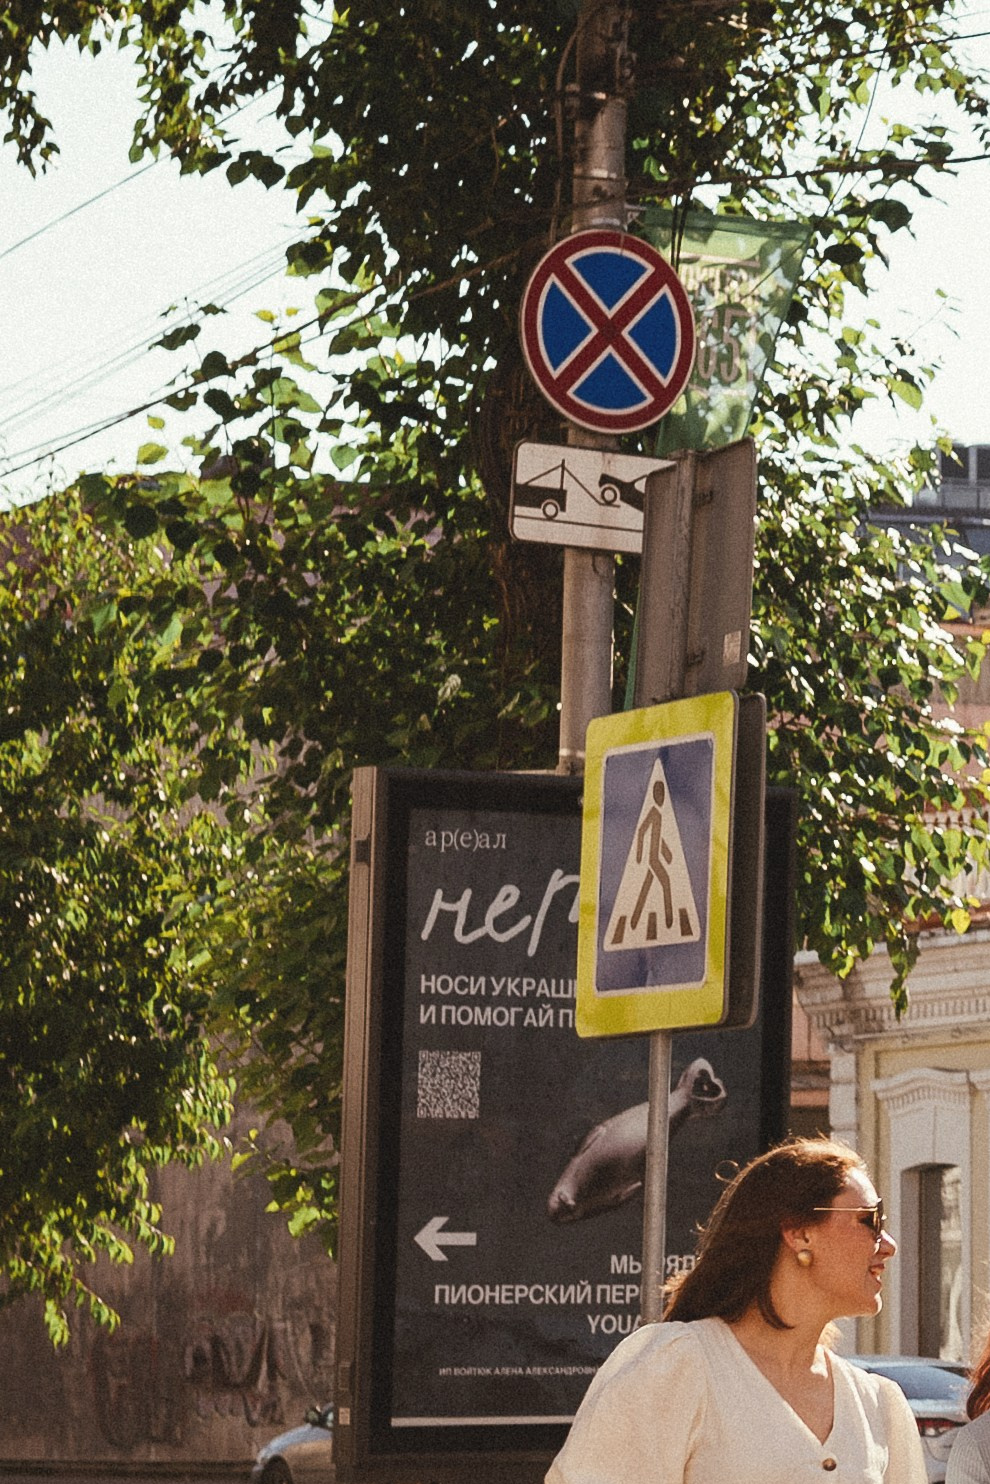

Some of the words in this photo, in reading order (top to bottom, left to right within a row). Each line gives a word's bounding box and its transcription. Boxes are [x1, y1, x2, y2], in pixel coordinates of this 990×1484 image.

[420, 974, 486, 996] НОСИ
[491, 976, 577, 999] УКРАШ
[419, 1004, 437, 1025] И
[441, 1003, 554, 1028] ПОМОГАЙ
[559, 1008, 577, 1028] П
[434, 1280, 591, 1305] ПИОНЕРСКИЙ
[596, 1284, 641, 1305] ПЕР
[438, 1366, 453, 1376] ИП
[493, 1365, 524, 1376] АЛЕНА
[525, 1365, 600, 1377] АЛЕКСАНДРОВН
